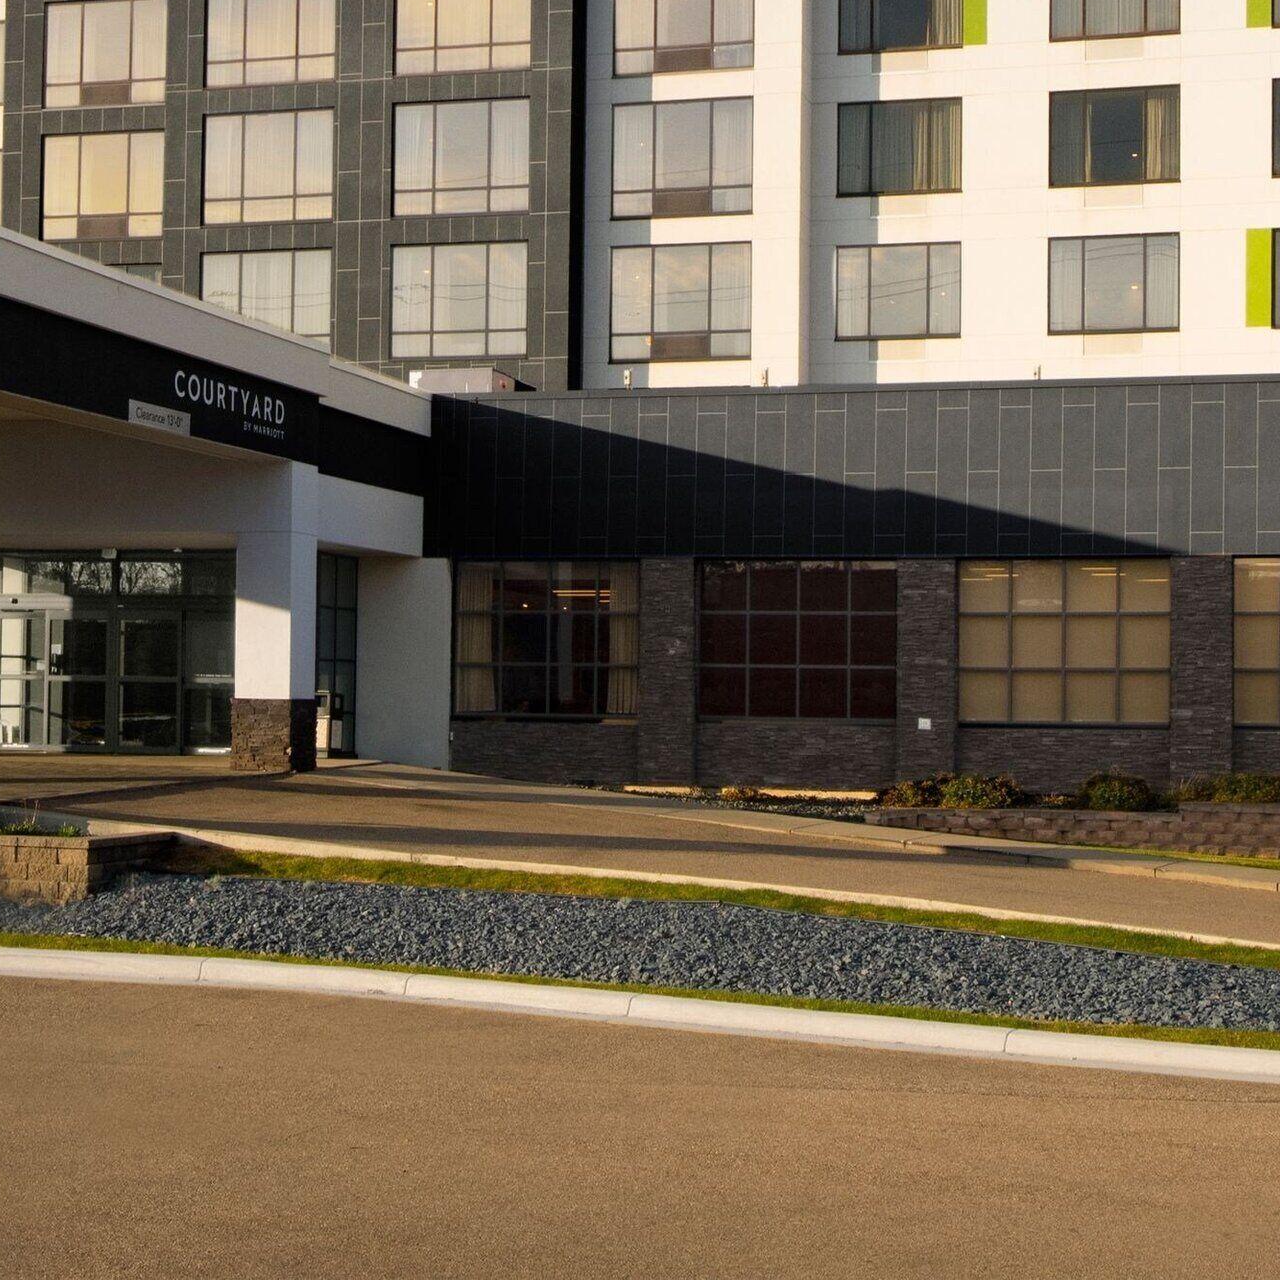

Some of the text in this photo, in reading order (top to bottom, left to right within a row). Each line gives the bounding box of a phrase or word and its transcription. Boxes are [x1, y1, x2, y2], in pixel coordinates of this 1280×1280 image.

[174, 371, 285, 424] COURTYARD
[243, 421, 285, 440] BY MARRIOTT
